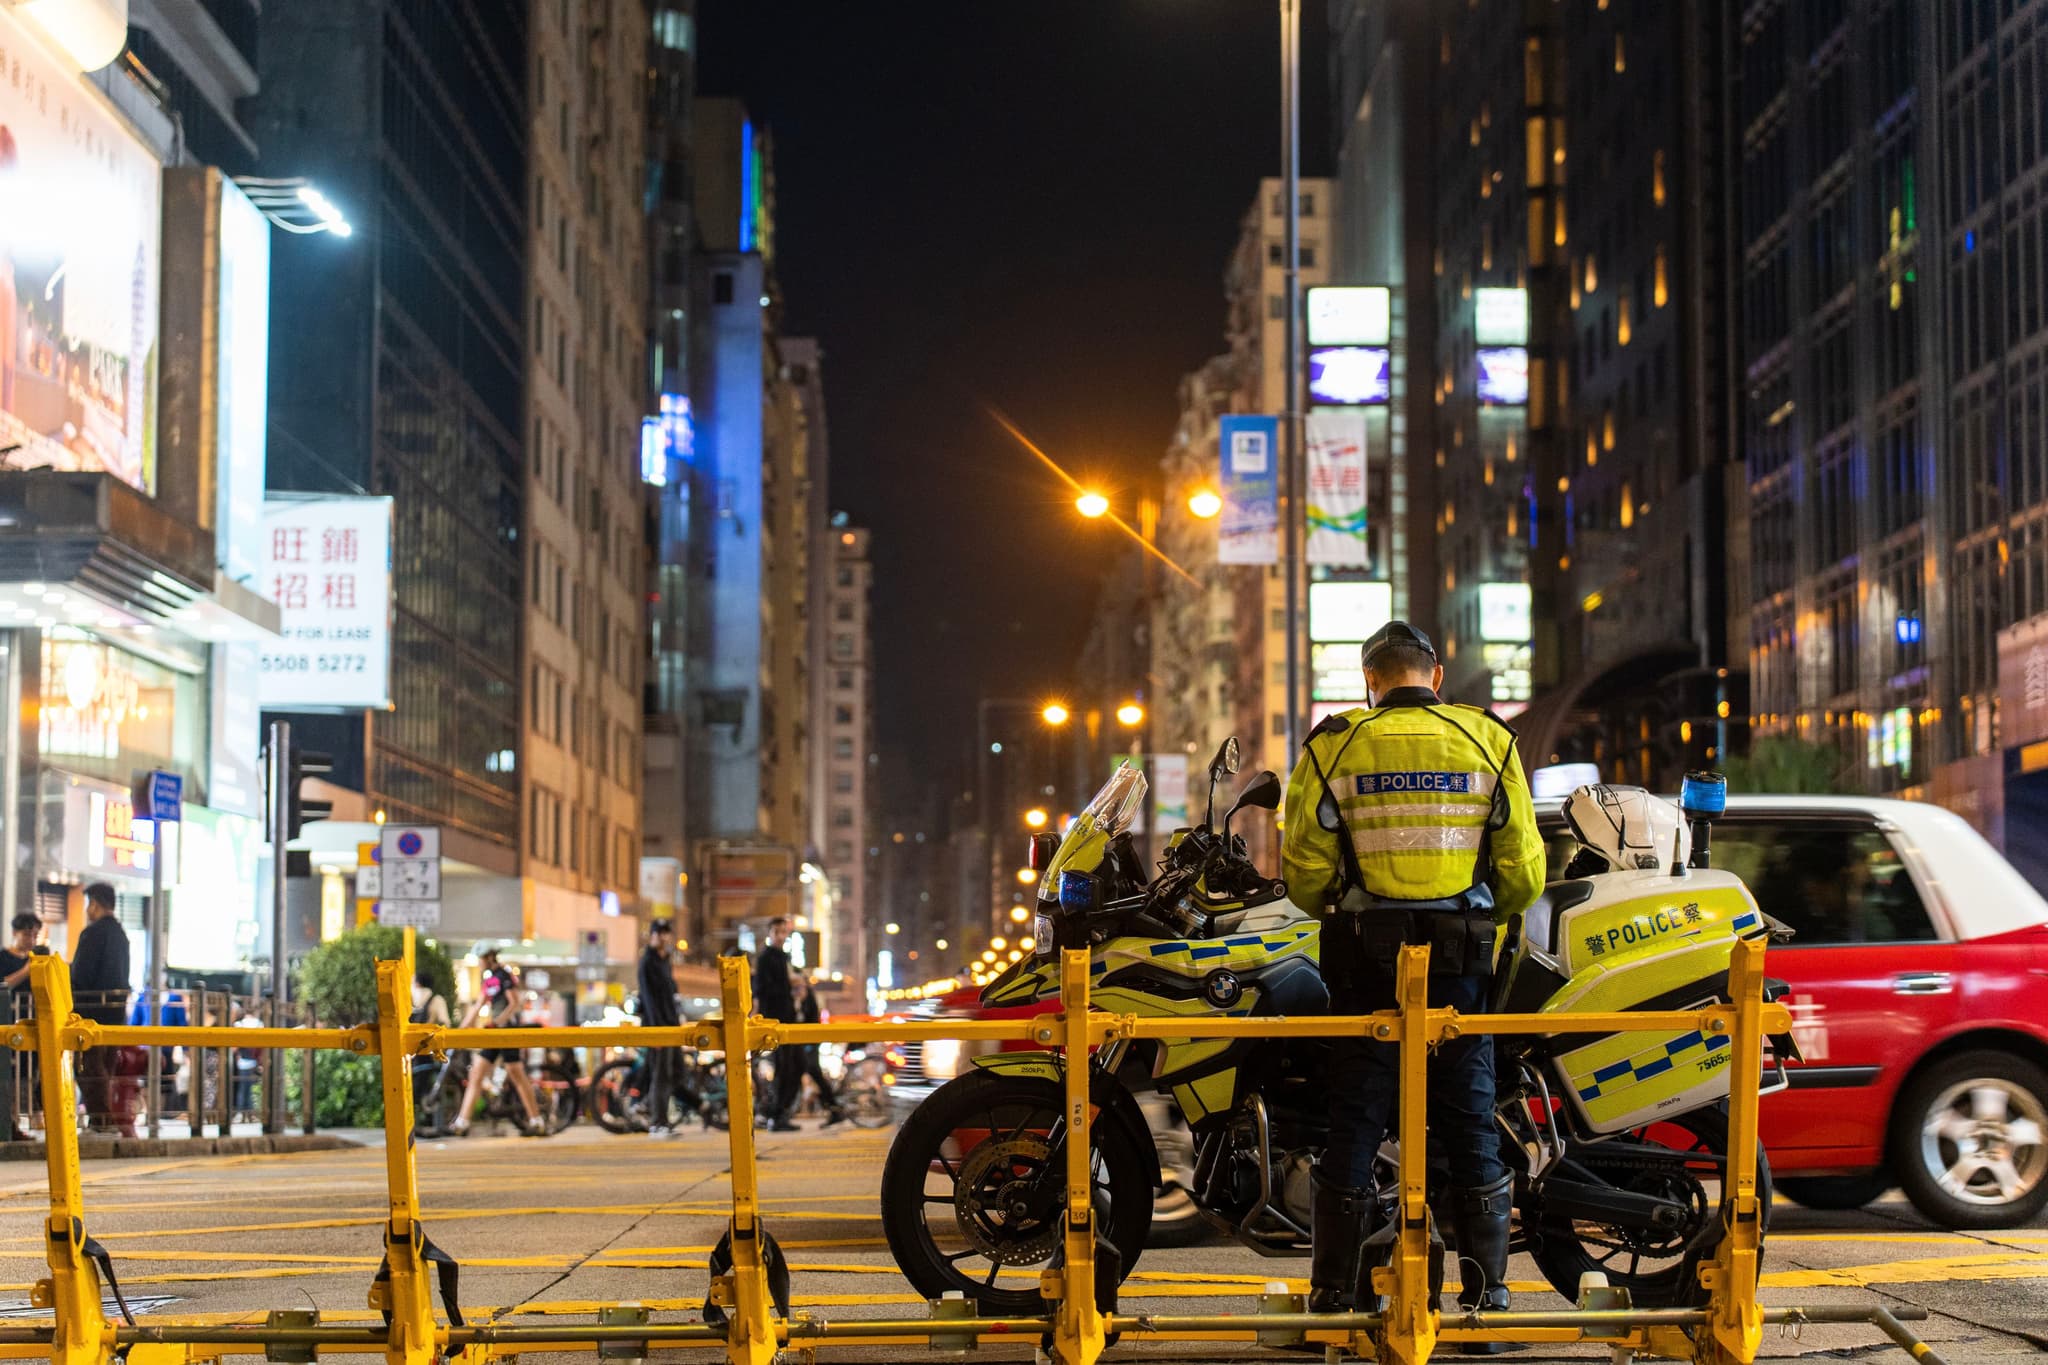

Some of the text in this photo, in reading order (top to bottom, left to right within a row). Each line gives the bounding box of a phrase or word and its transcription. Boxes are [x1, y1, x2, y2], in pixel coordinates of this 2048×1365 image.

[273, 571, 357, 609] 招租
[297, 626, 323, 639] FOR
[329, 626, 372, 639] LEASE
[261, 654, 366, 672] 5508 5272
[1380, 774, 1444, 790] POLICE
[1606, 907, 1683, 950] POLICE
